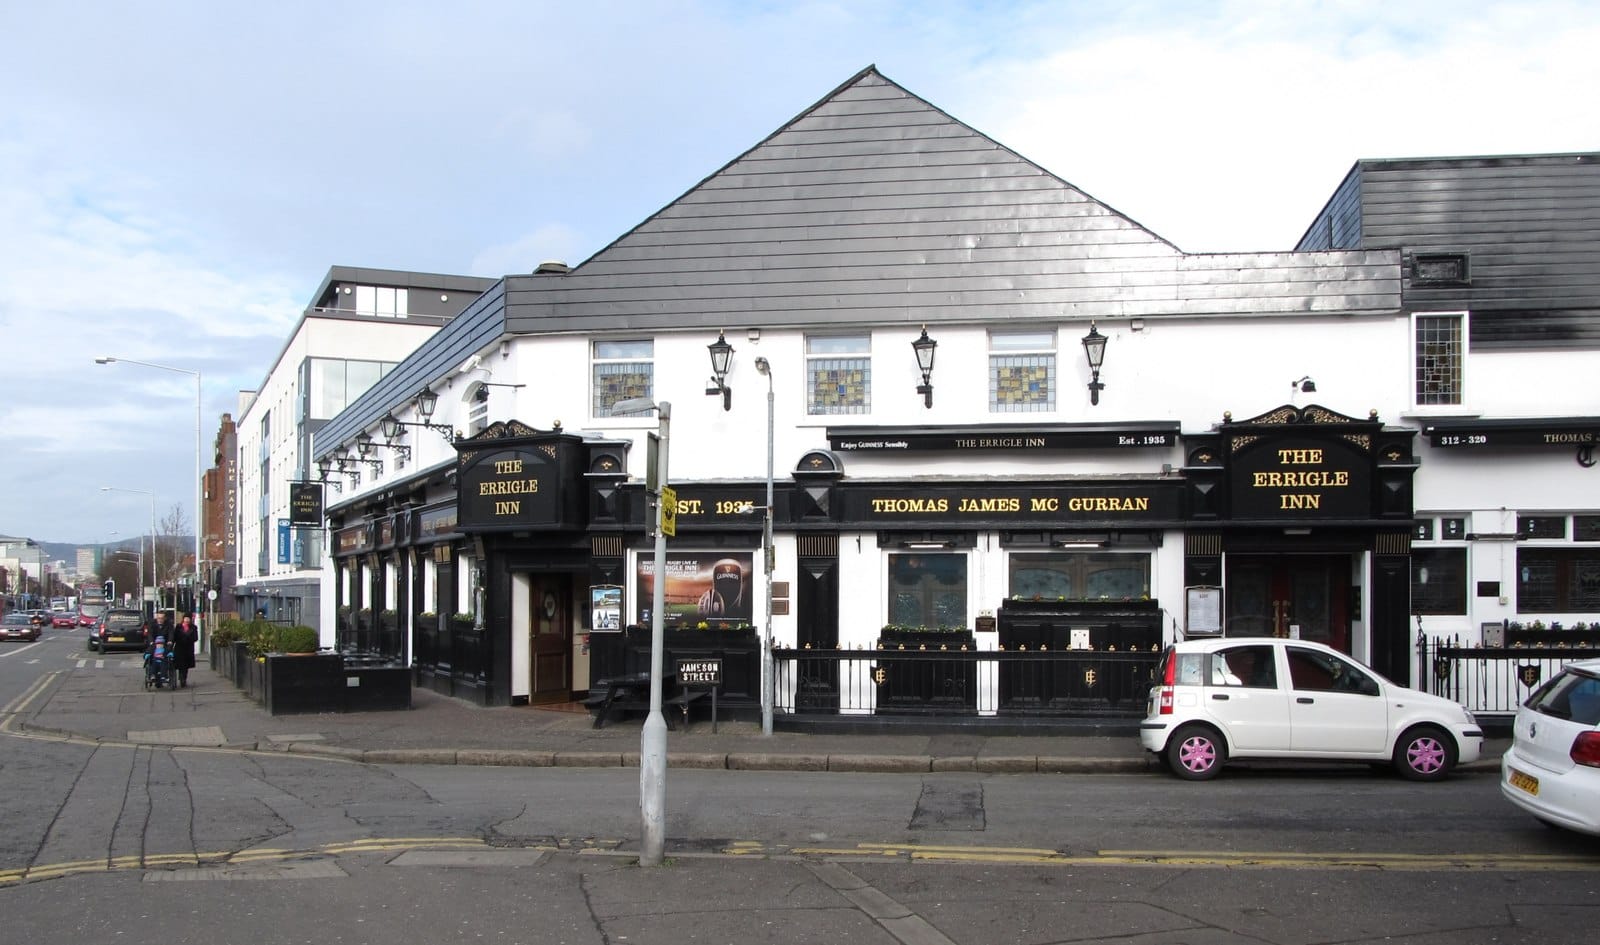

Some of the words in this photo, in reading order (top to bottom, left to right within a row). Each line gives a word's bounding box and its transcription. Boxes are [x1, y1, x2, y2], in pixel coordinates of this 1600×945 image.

[956, 439, 976, 448] THE
[979, 438, 1022, 448] ERRIGLE
[1025, 438, 1045, 447] INN
[1119, 436, 1134, 445] Est
[1143, 436, 1165, 445] 1935
[1441, 436, 1459, 445] 312
[1468, 435, 1487, 444] 320
[1543, 433, 1592, 443] THOMAS
[841, 442, 857, 450] Enjoy
[1278, 449, 1322, 464] THE
[495, 460, 522, 474] THE
[1253, 471, 1349, 487] ERRIGLE
[479, 479, 538, 496] ERRIGLE
[495, 501, 520, 515] INN
[675, 500, 704, 514] ST.
[872, 499, 948, 513] THOMAS
[958, 498, 1020, 512] JAMES
[1030, 498, 1059, 511] MC
[1068, 497, 1149, 511] GURRAN
[1280, 494, 1321, 509] INN
[227, 489, 235, 546] PAVILION
[680, 663, 718, 672] JAMESON
[683, 672, 715, 681] STREET
